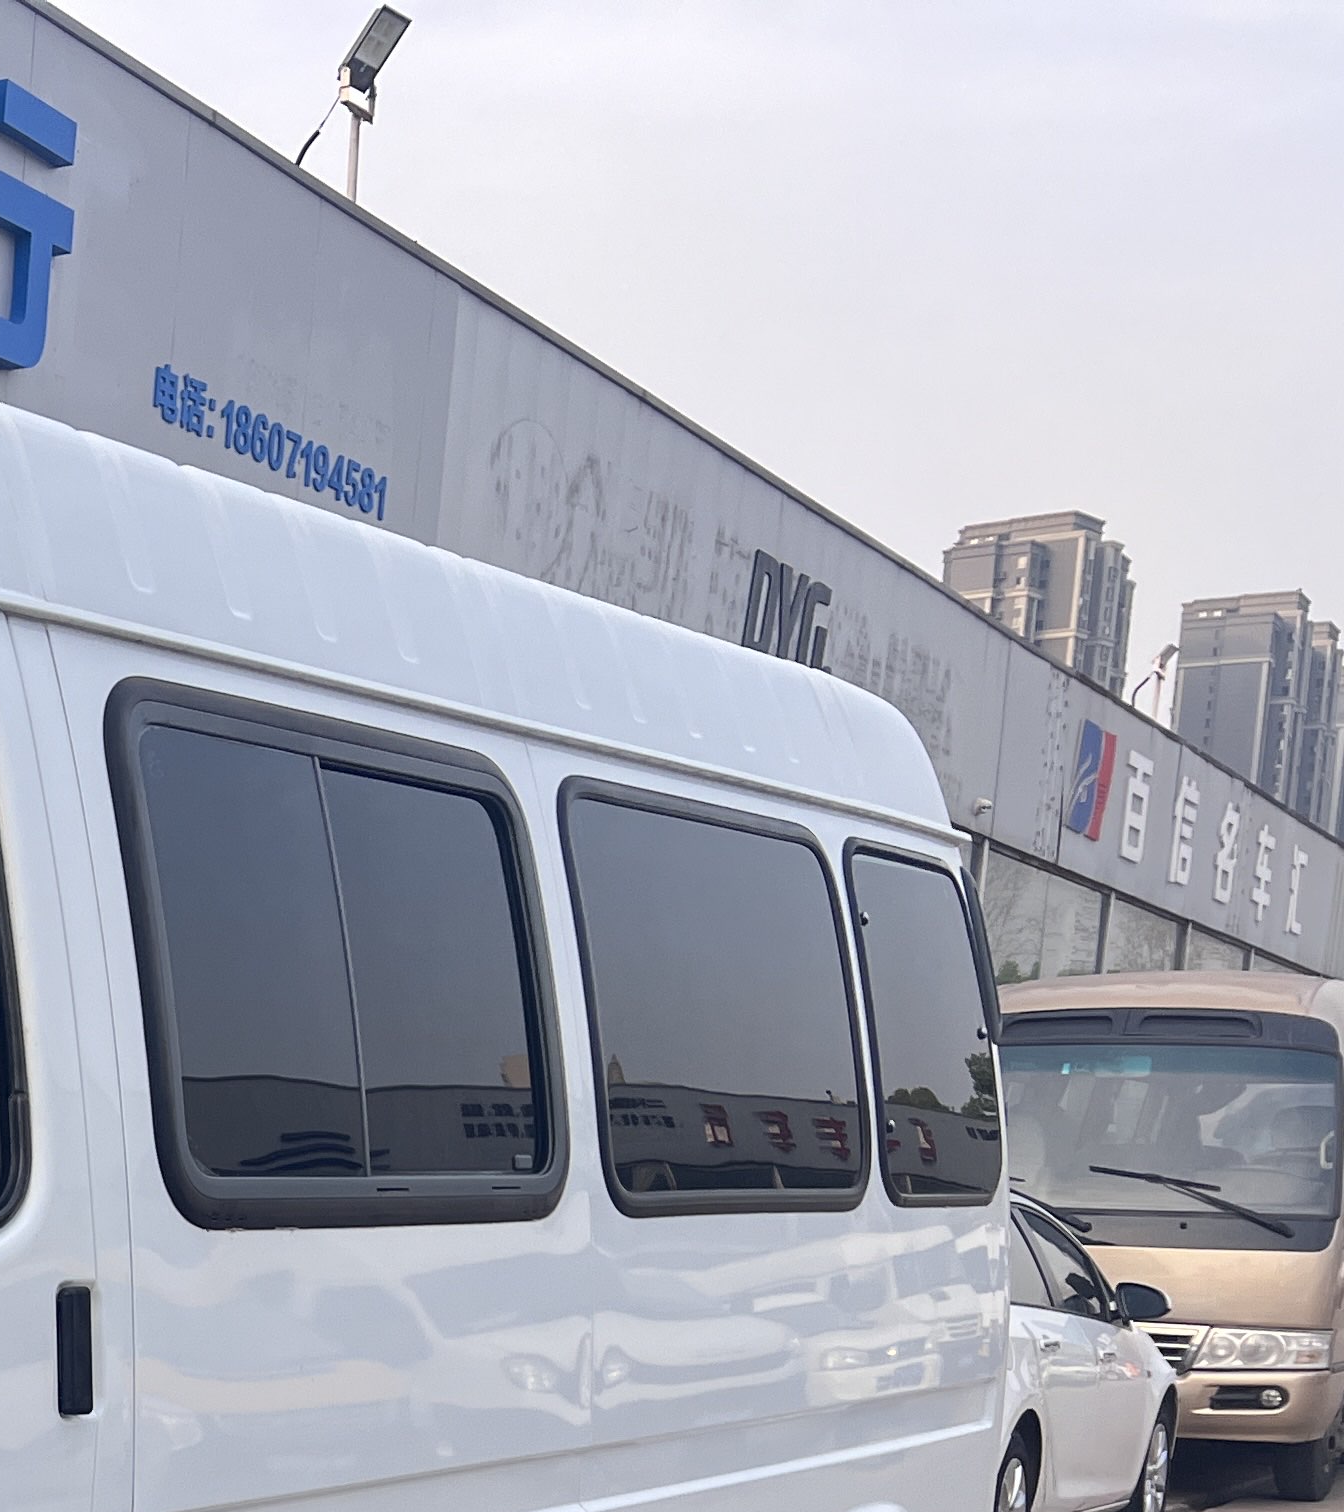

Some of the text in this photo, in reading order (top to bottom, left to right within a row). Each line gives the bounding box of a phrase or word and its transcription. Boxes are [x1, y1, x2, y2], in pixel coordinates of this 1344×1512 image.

[152, 364, 388, 521] 电话:18607194581
[1119, 749, 1308, 936] 百信名车汇
